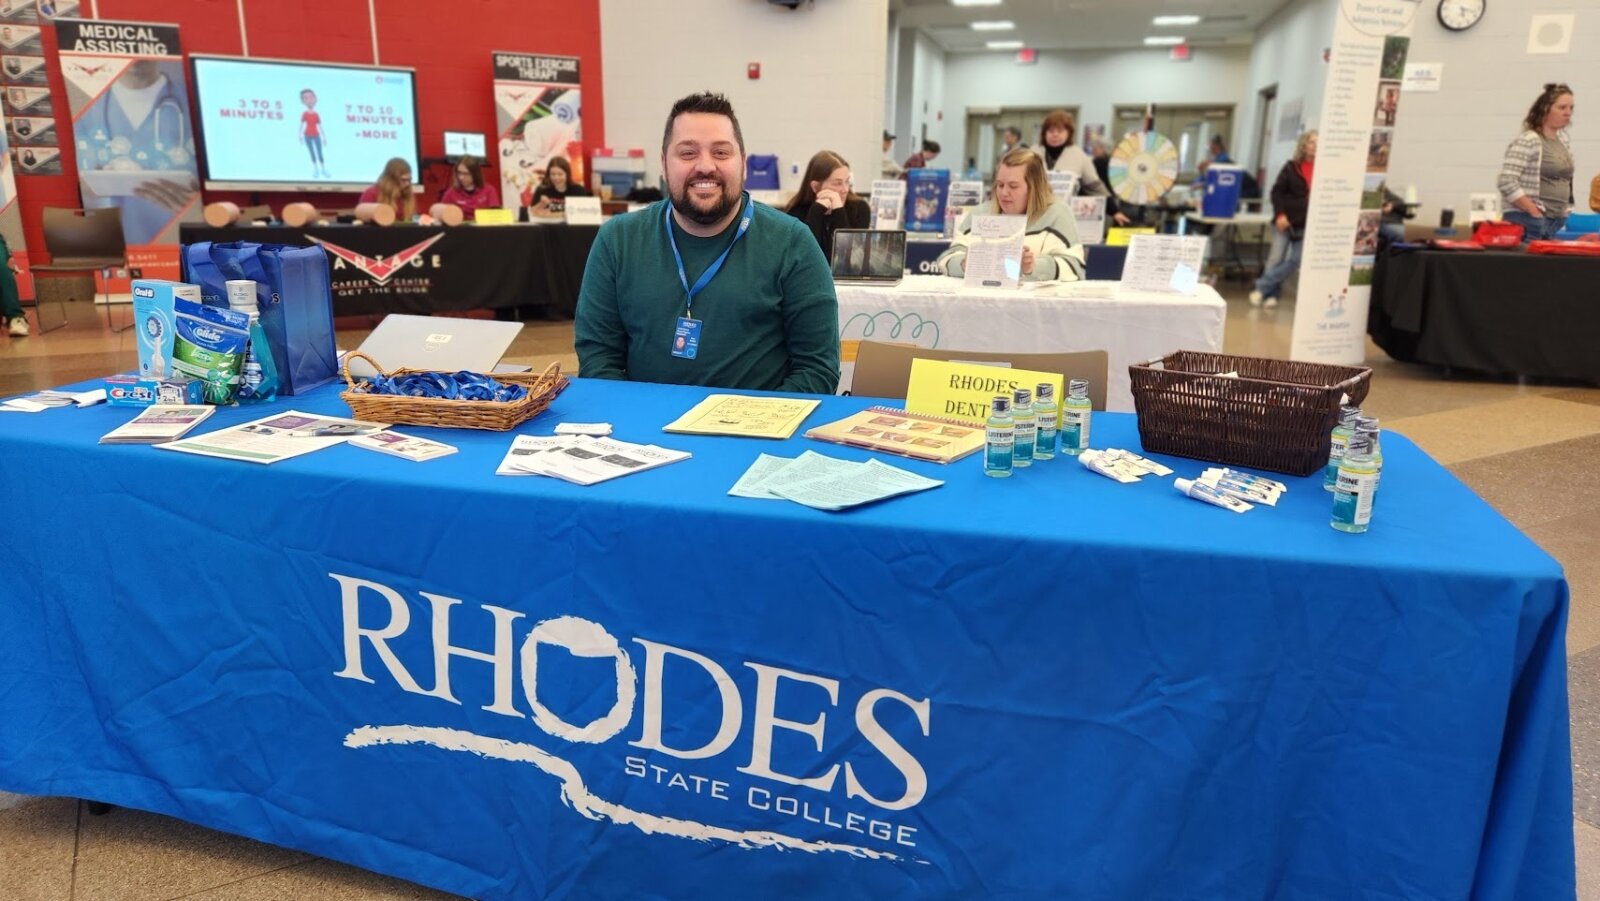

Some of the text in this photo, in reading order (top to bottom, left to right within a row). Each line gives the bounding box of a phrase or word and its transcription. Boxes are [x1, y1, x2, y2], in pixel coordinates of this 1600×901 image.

[78, 24, 159, 42] MEDICAL
[74, 39, 168, 55] ASSISTING
[495, 55, 577, 72] SPORTS EXERCISE
[518, 67, 558, 80] THERAPY
[238, 98, 283, 110] 3 TO 5
[345, 104, 393, 115] 7 TO 10
[219, 108, 284, 121] MINUTES
[345, 114, 404, 126] MINUTES
[331, 277, 430, 288] CAREER CENTER
[338, 288, 363, 296] GET
[196, 326, 221, 341] Glide
[949, 373, 1019, 395] RHODES
[110, 387, 154, 400] Crest
[944, 400, 990, 418] DENT
[328, 572, 931, 811] RHODES
[625, 756, 918, 847] STATE COLLEGE
